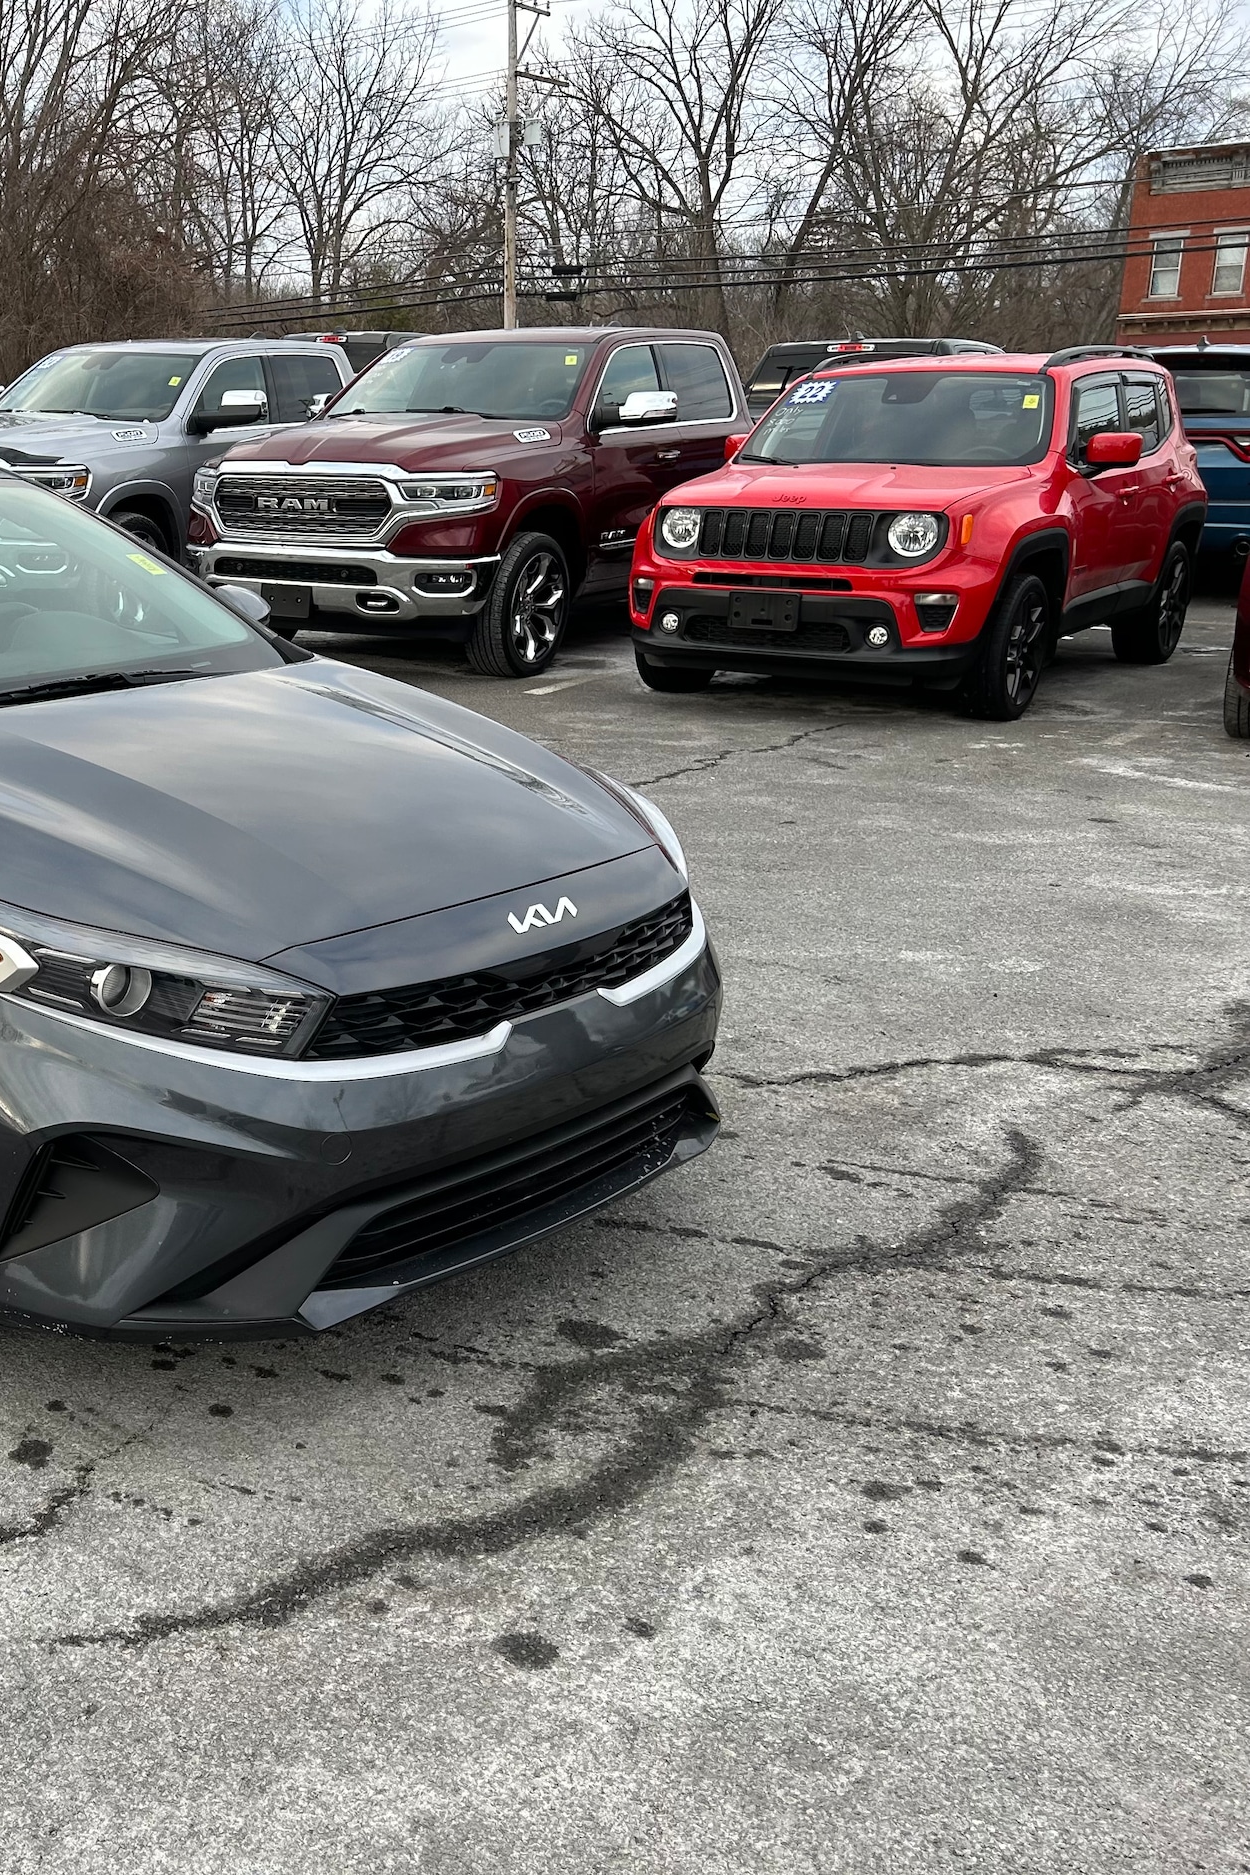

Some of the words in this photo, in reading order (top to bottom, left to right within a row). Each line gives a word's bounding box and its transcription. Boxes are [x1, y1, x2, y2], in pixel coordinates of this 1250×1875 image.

[798, 385, 826, 399] 22
[775, 406, 803, 417] Only
[257, 497, 328, 511] RAM
[772, 494, 807, 505] Jeep
[507, 896, 578, 934] KIA
